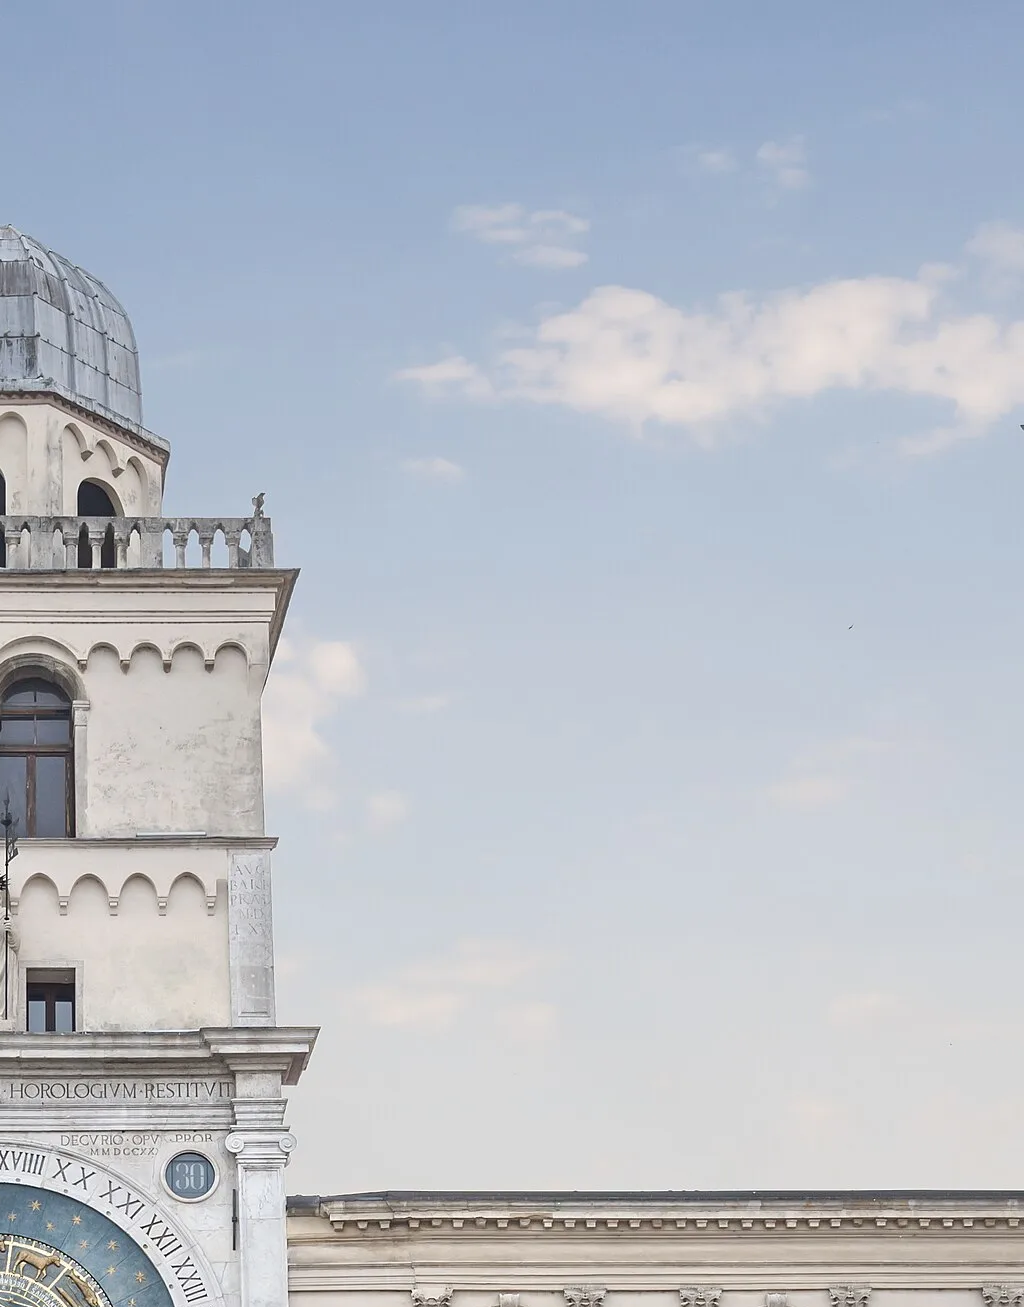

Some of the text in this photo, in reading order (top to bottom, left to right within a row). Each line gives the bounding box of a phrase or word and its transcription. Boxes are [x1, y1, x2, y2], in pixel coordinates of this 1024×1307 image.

[10, 1082, 139, 1099] HOROLOGIVM
[144, 1082, 234, 1098] RESTITVIT
[52, 1158, 96, 1190] XX
[176, 1162, 204, 1190] 30
[99, 1180, 145, 1220] XXI
[140, 1214, 182, 1258] XXII
[171, 1256, 208, 1303] XXIII
